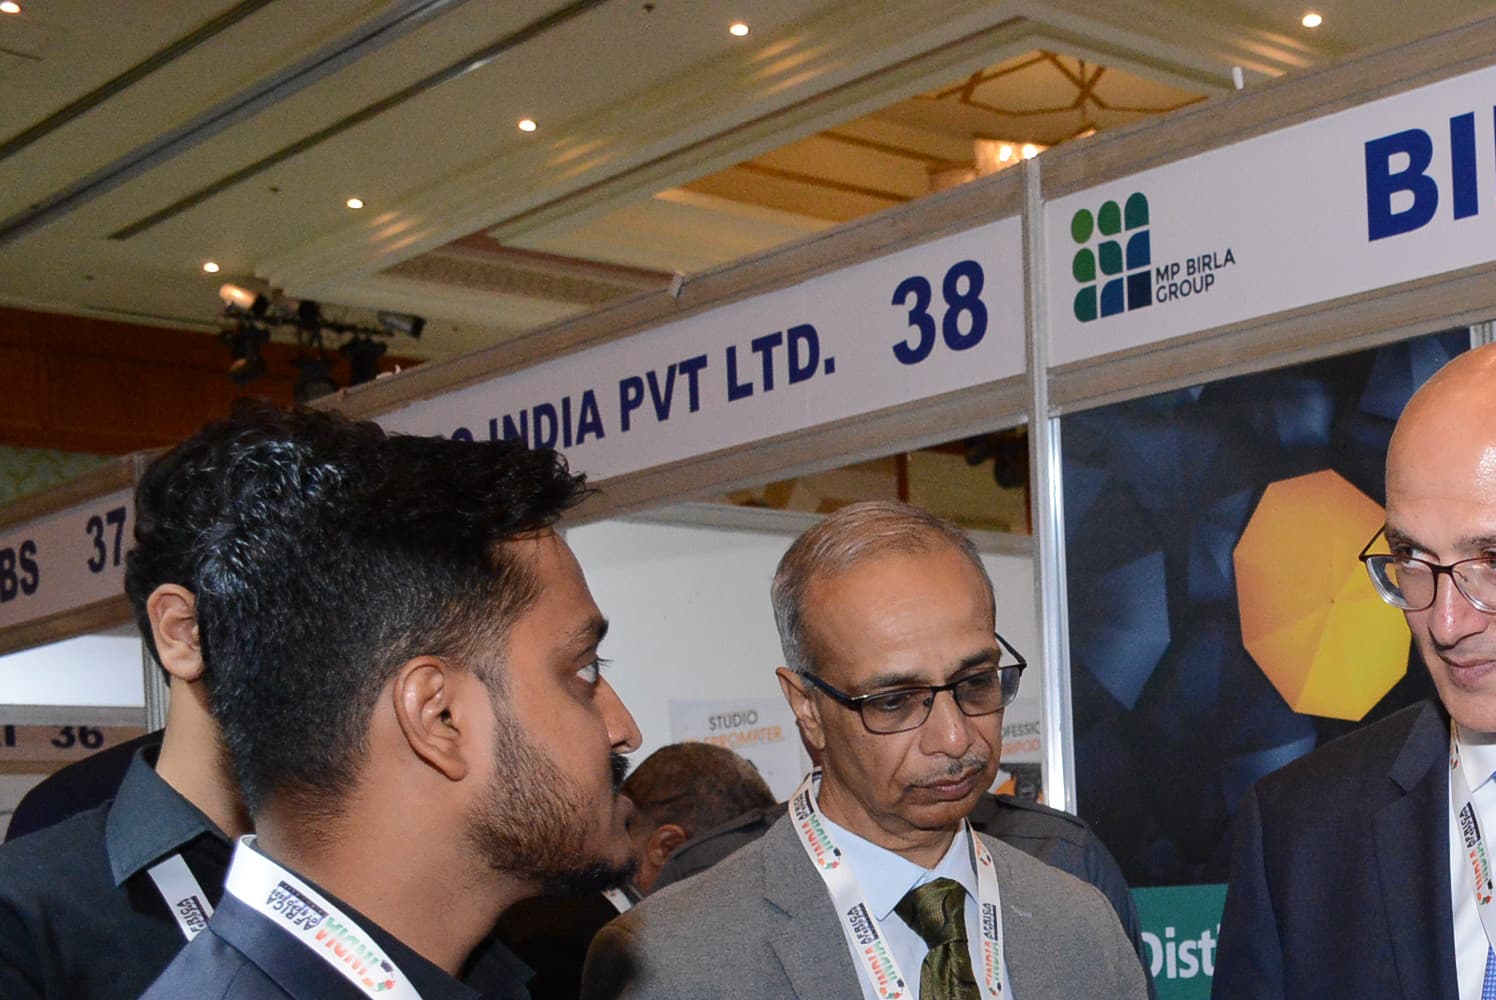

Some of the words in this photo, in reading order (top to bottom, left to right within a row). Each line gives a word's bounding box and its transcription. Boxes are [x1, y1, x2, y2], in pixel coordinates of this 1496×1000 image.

[1156, 263, 1181, 284] MP
[1186, 248, 1236, 276] BIRLA
[1156, 273, 1215, 303] GROUP
[619, 354, 709, 431] PVT
[725, 323, 836, 402] LTD.
[890, 259, 989, 365] 38
[86, 506, 127, 573] 37
[51, 725, 104, 749] 36
[708, 709, 758, 731] STUDIO
[266, 896, 313, 930] AFRICA
[848, 907, 870, 945] AFRICA
[315, 917, 380, 976] INDIA
[865, 941, 898, 985] INDIA
[1141, 923, 1220, 979] Dist
